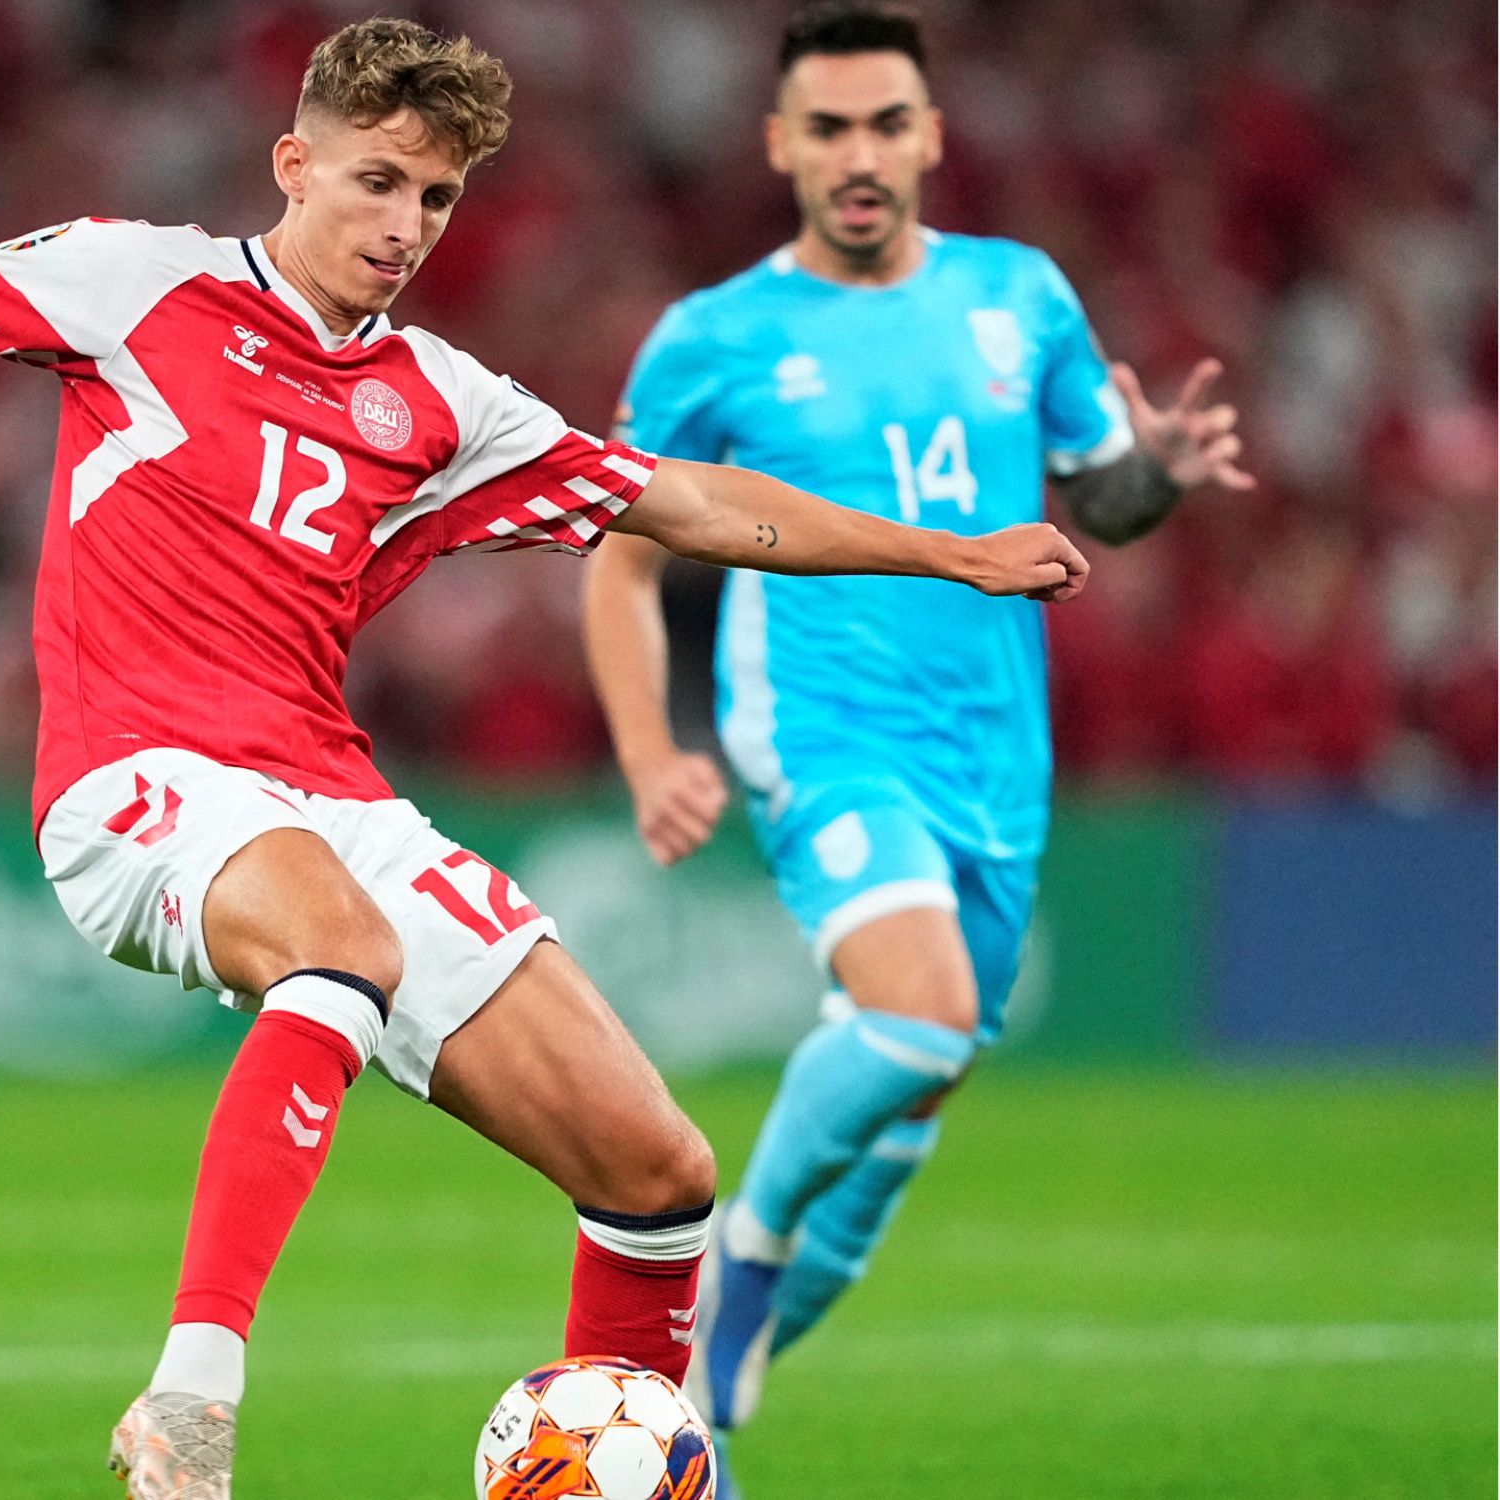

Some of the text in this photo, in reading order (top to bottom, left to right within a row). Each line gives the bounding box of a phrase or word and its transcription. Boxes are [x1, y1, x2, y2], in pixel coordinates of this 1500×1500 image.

[223, 345, 264, 377] hummel
[276, 372, 303, 391] DENMARK
[310, 390, 322, 401] SAN
[322, 396, 346, 412] MARINO
[363, 400, 399, 429] DBU
[249, 420, 347, 555] 12
[882, 414, 979, 525] 14
[410, 848, 542, 946] 12
